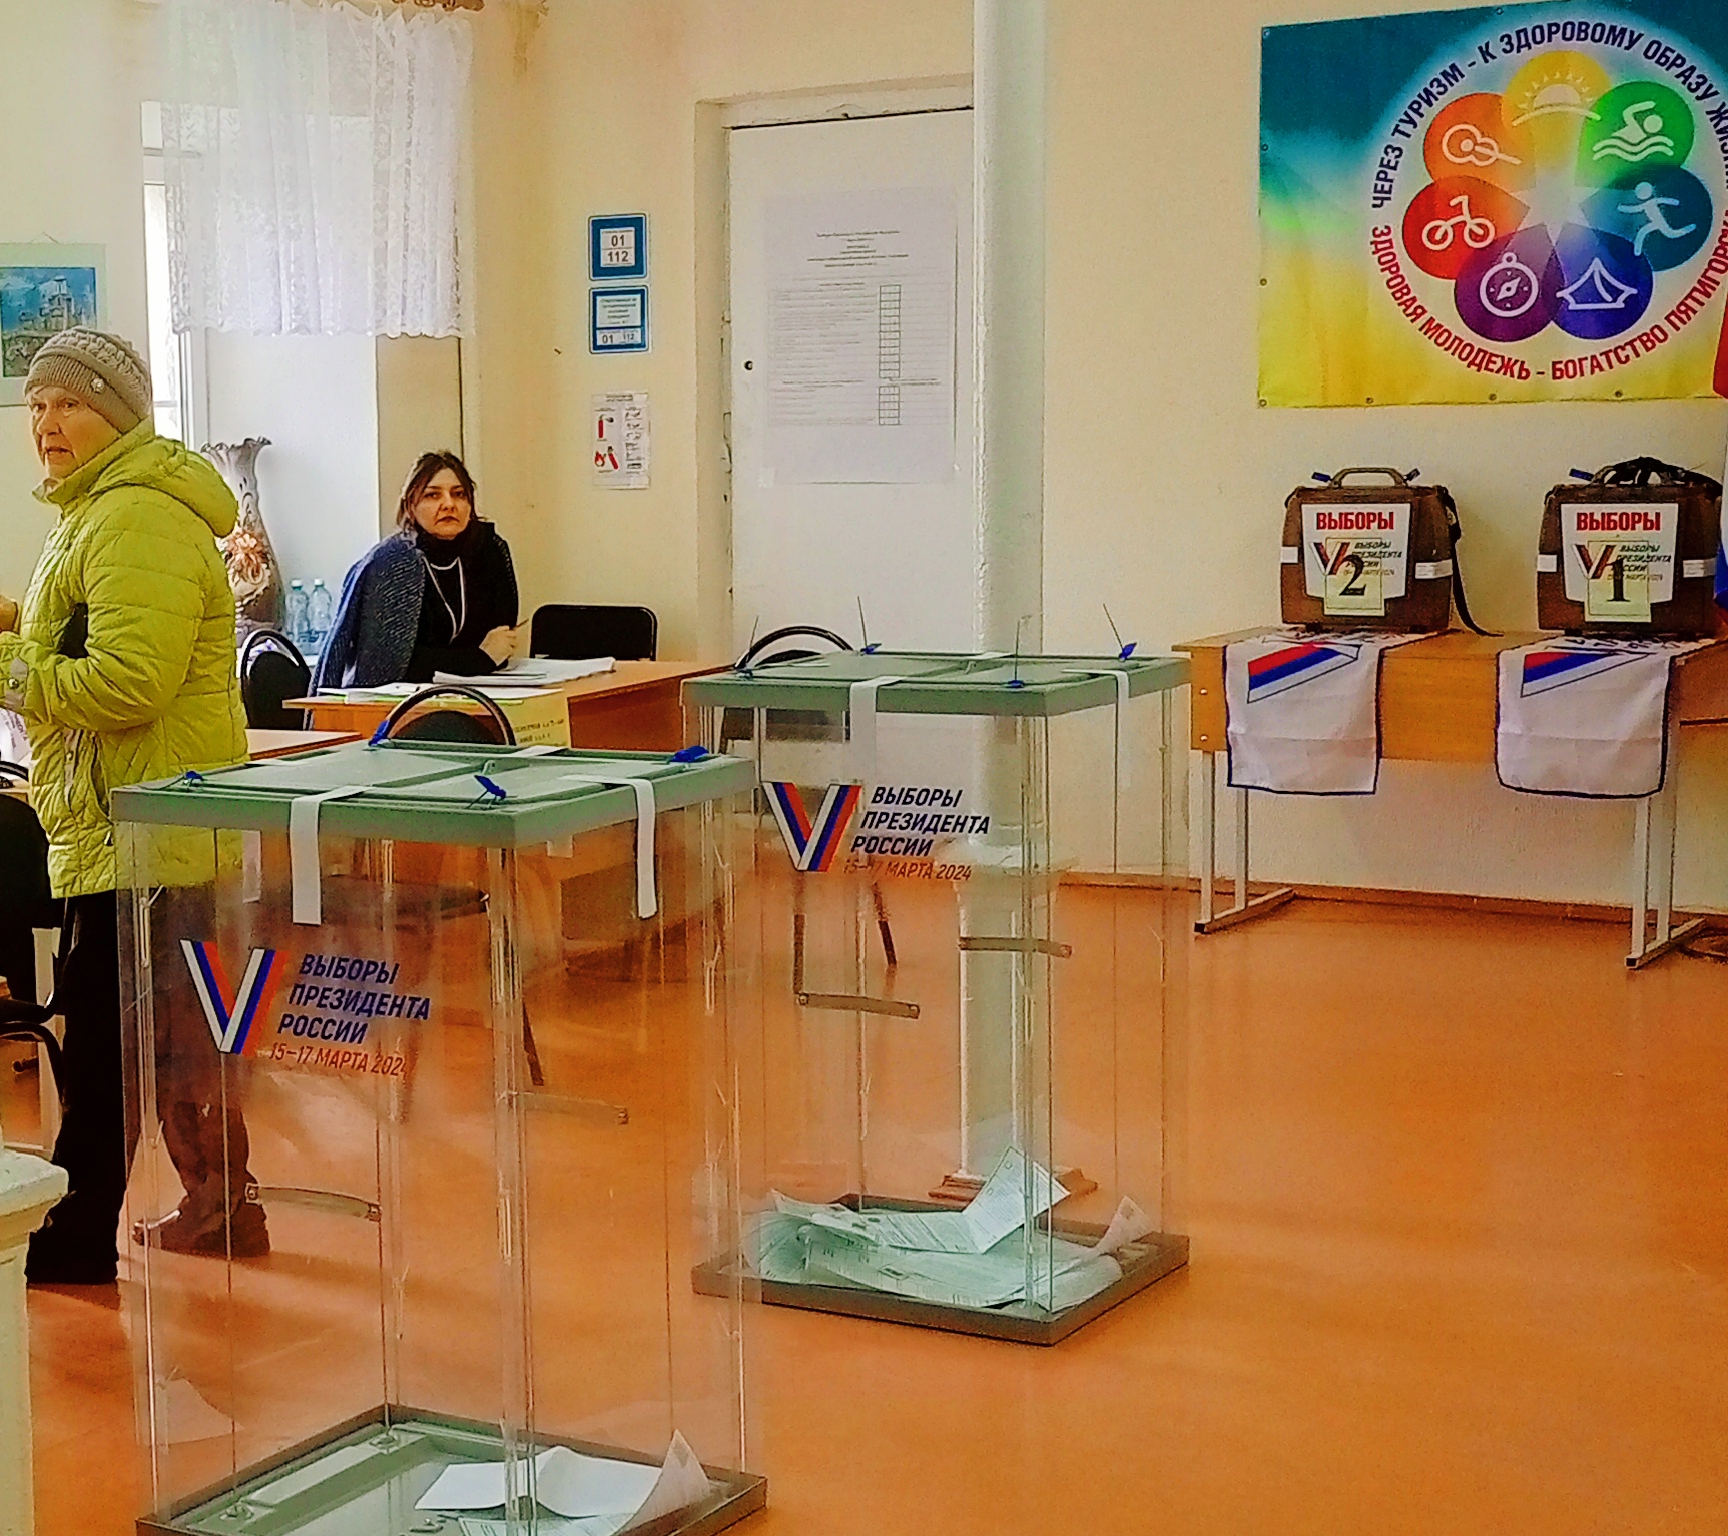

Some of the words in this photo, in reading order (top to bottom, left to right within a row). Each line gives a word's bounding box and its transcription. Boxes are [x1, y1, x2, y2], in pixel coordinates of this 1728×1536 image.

[1372, 144, 1403, 208] ЧЕРЕЗ
[1391, 63, 1465, 139] ТУРИЗМ
[1477, 41, 1497, 64] К
[1499, 21, 1645, 54] ЗДОРОВОМУ
[1643, 40, 1720, 101] ОБРАЗУ
[611, 234, 625, 247] 01
[607, 250, 629, 263] 112
[1370, 224, 1428, 324] ЗДОРОВАЯ
[1418, 316, 1531, 380] МОЛОДЕЖЬ
[1552, 324, 1669, 380] БОГАТСТВО
[601, 334, 614, 344] 01
[1316, 512, 1394, 530] ВЫБОРЫ
[1576, 512, 1661, 531] ВЫБОРЫ
[1338, 554, 1367, 596] 2
[1606, 558, 1631, 602] 1
[871, 786, 963, 807] ВЫБОРЫ
[860, 811, 990, 834] ПРЕЗИДЕНТА
[851, 836, 934, 857] РОССИИ
[885, 861, 932, 879] МАРТА
[936, 864, 972, 880] 2024
[299, 953, 400, 985] ВЫБОРЫ
[289, 983, 431, 1020] ПРЕЗИДЕНТА
[277, 1014, 368, 1044] РОССИИ
[315, 1048, 369, 1073] МАРТА
